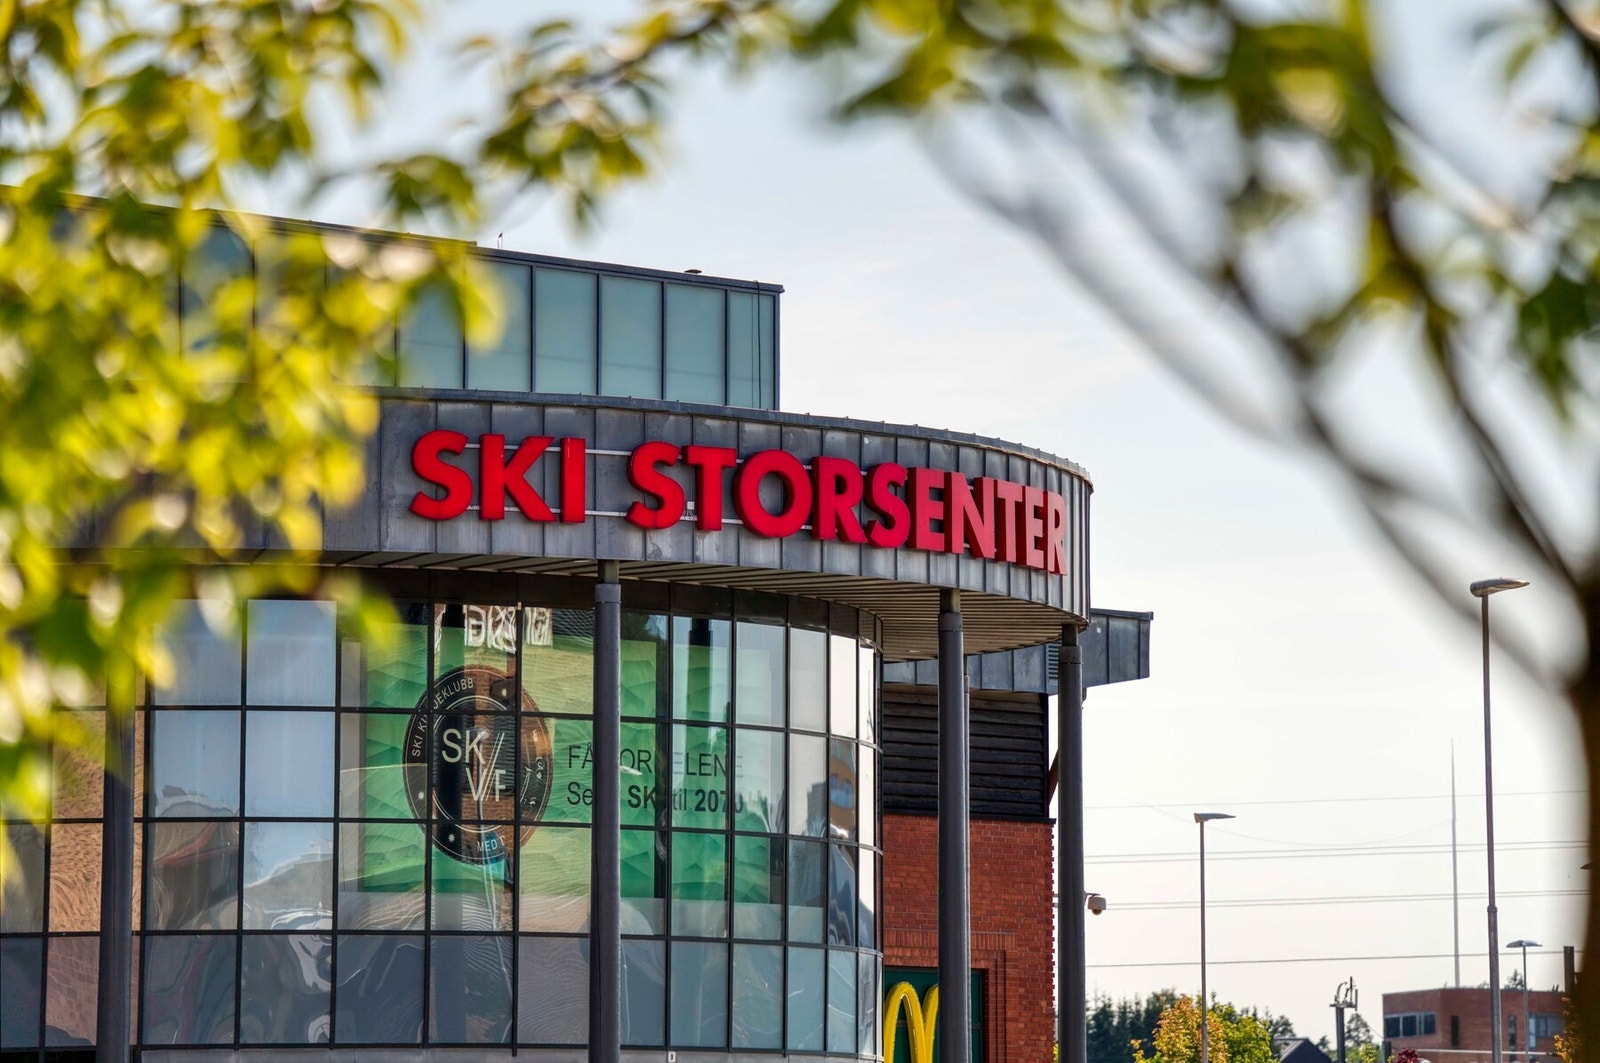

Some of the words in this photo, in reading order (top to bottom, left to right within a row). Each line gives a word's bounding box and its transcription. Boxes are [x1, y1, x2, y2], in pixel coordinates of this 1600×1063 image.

[408, 429, 586, 522] SKI
[626, 440, 1069, 575] STORSENTER
[411, 734, 424, 758] SKI
[567, 741, 594, 769] FÅ
[671, 787, 687, 811] til
